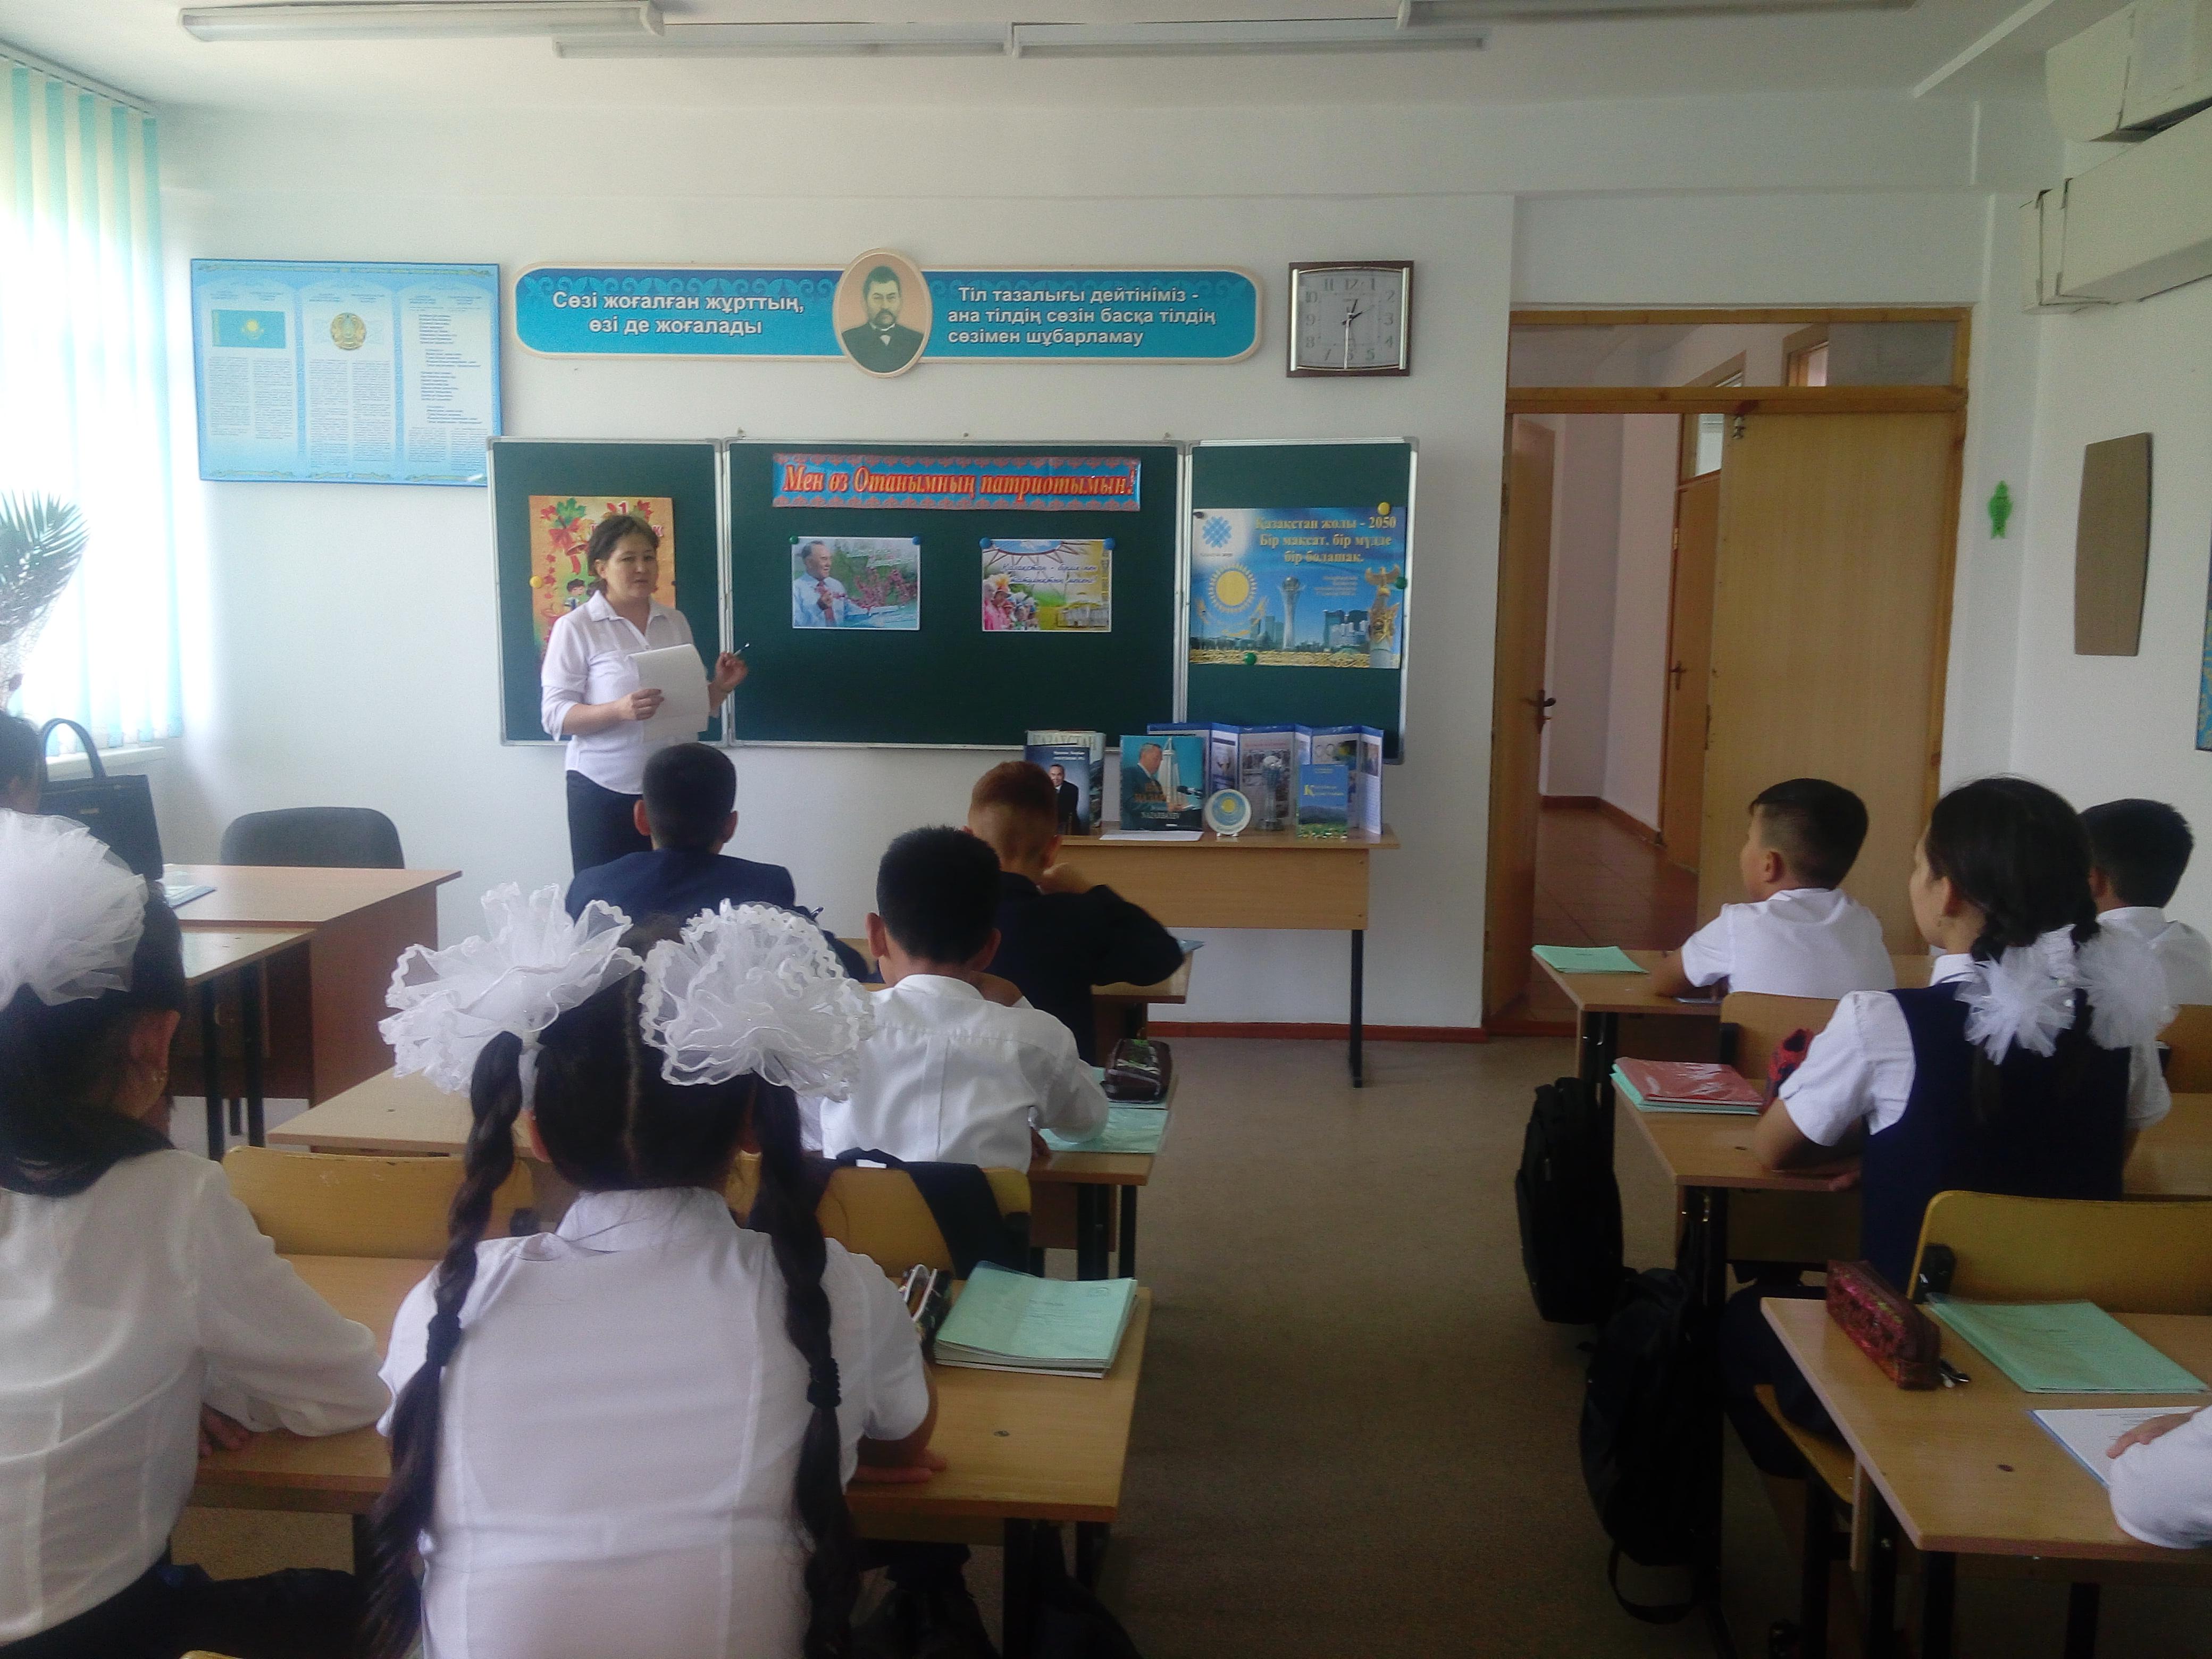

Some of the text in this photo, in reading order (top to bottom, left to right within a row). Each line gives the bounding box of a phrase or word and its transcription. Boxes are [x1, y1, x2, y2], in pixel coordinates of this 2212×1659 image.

[552, 291, 805, 314] Сөзі жоғалған жұрттың,
[958, 287, 987, 302] Тіл
[992, 290, 1085, 303] тазалығы
[1090, 287, 1187, 305] дейтініміз
[948, 307, 1217, 325] ана тілдің сөзін басқа тілдің
[589, 315, 763, 337] өзі де жоғалады
[948, 328, 1144, 347] сөзімен шұбарламау
[782, 464, 825, 492] Мен
[828, 472, 849, 492] өз
[1369, 516, 1397, 529] 2050
